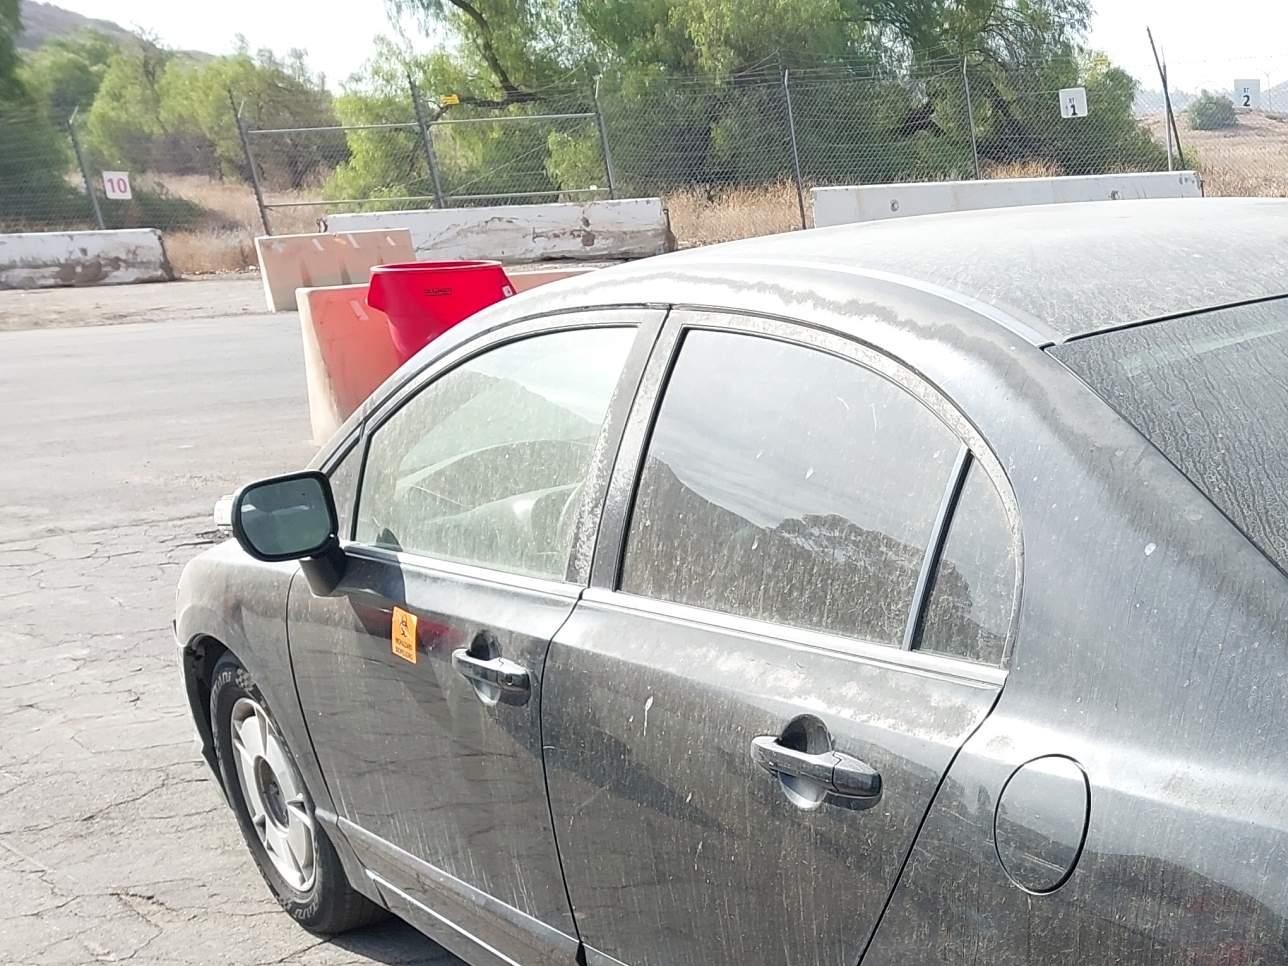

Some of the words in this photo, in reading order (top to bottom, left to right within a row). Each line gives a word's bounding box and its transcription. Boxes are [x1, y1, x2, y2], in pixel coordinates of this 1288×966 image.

[1243, 94, 1250, 106] 2
[1070, 104, 1077, 116] 1
[107, 178, 127, 193] 10
